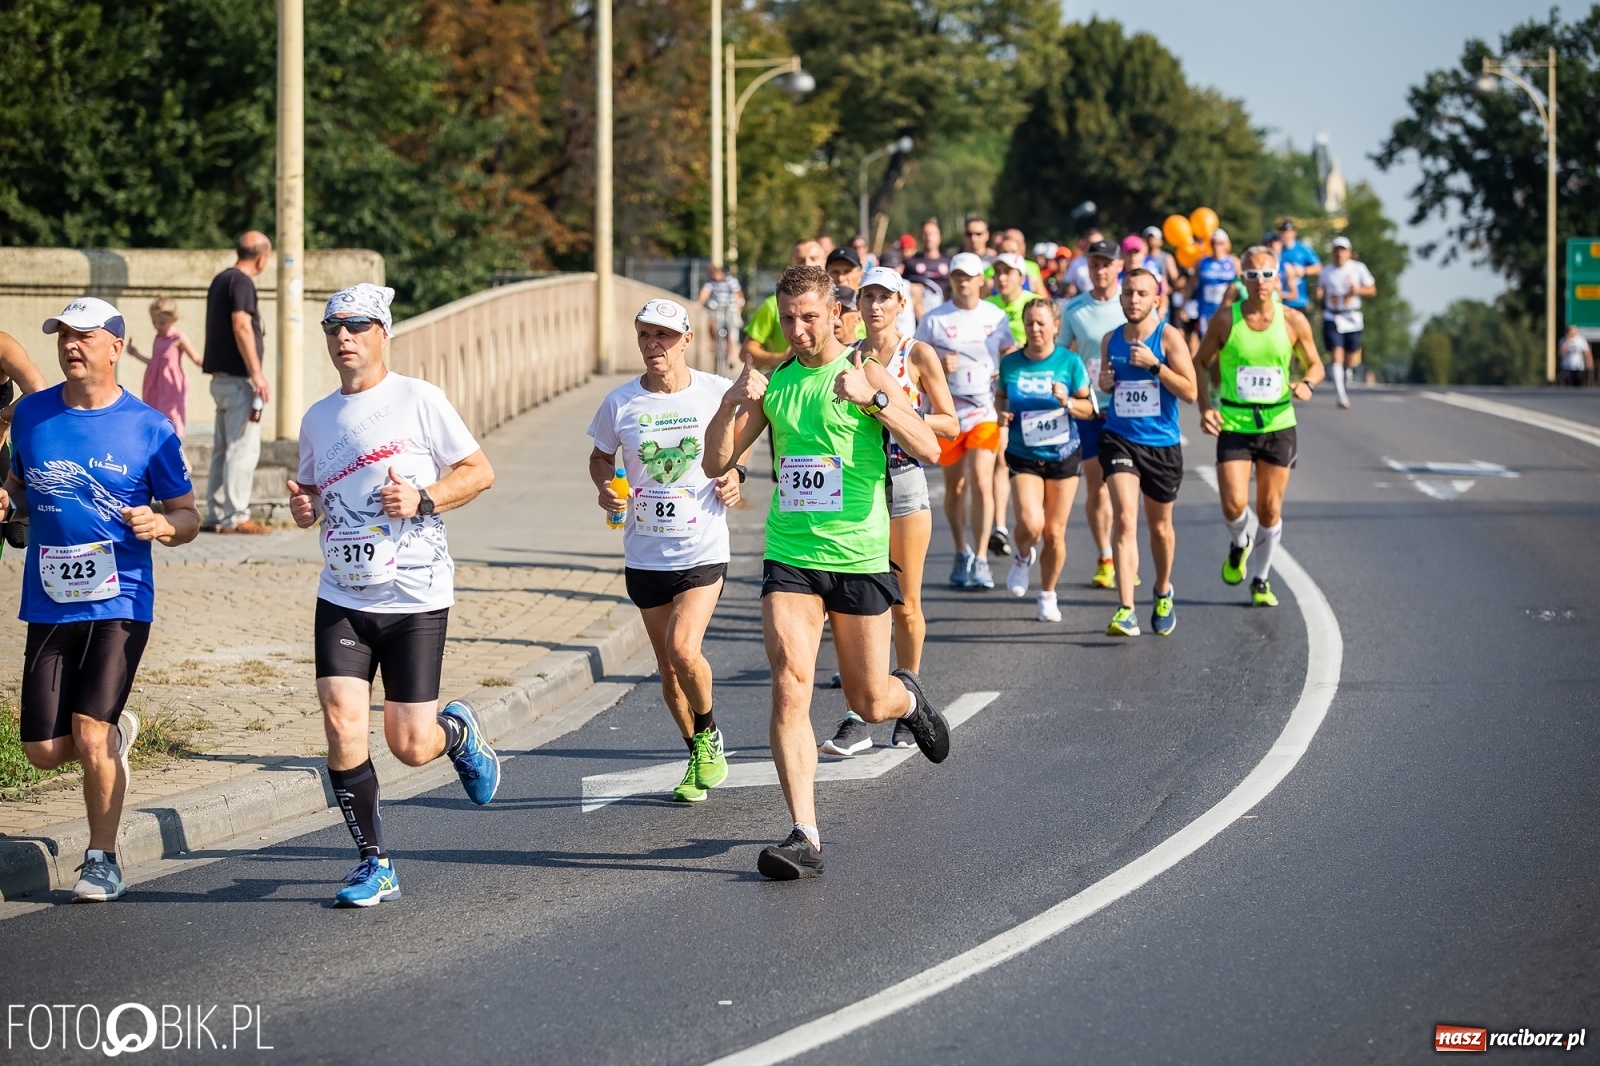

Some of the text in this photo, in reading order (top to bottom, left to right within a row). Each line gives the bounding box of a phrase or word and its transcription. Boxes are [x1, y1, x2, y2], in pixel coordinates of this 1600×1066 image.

[1251, 376, 1272, 387] 382
[1125, 390, 1148, 402] 206
[326, 434, 350, 460] GRYF
[351, 405, 393, 438] KIETRZ
[1036, 418, 1058, 431] 463
[792, 470, 825, 489] 360
[655, 501, 676, 517] 82
[343, 542, 375, 563] 379
[60, 560, 97, 580] 223
